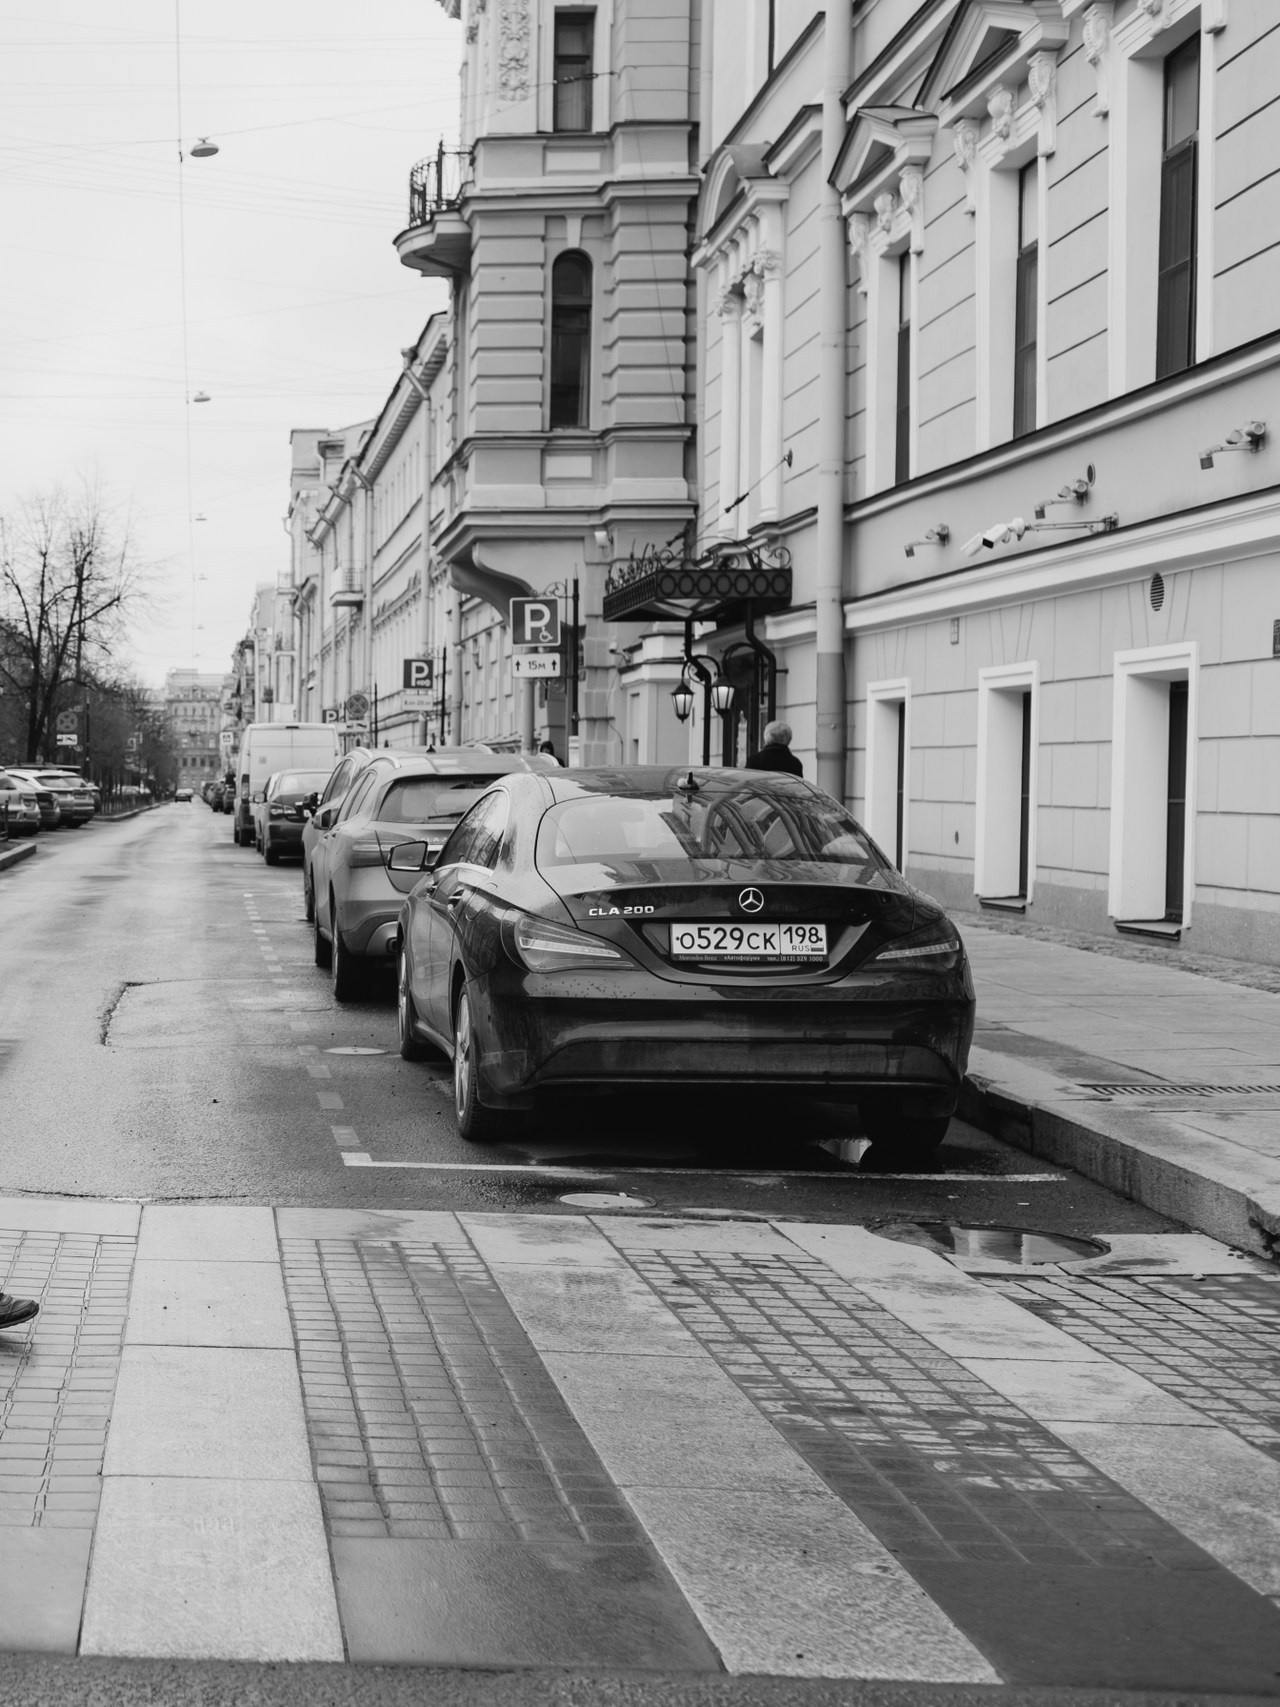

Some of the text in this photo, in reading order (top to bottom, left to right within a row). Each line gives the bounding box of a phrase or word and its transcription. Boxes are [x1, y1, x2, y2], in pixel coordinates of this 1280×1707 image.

[525, 604, 550, 641] P
[411, 661, 429, 687] P
[326, 711, 337, 723] P
[589, 905, 655, 916] CLA 200
[783, 926, 820, 944] 198
[791, 944, 810, 952] RUS
